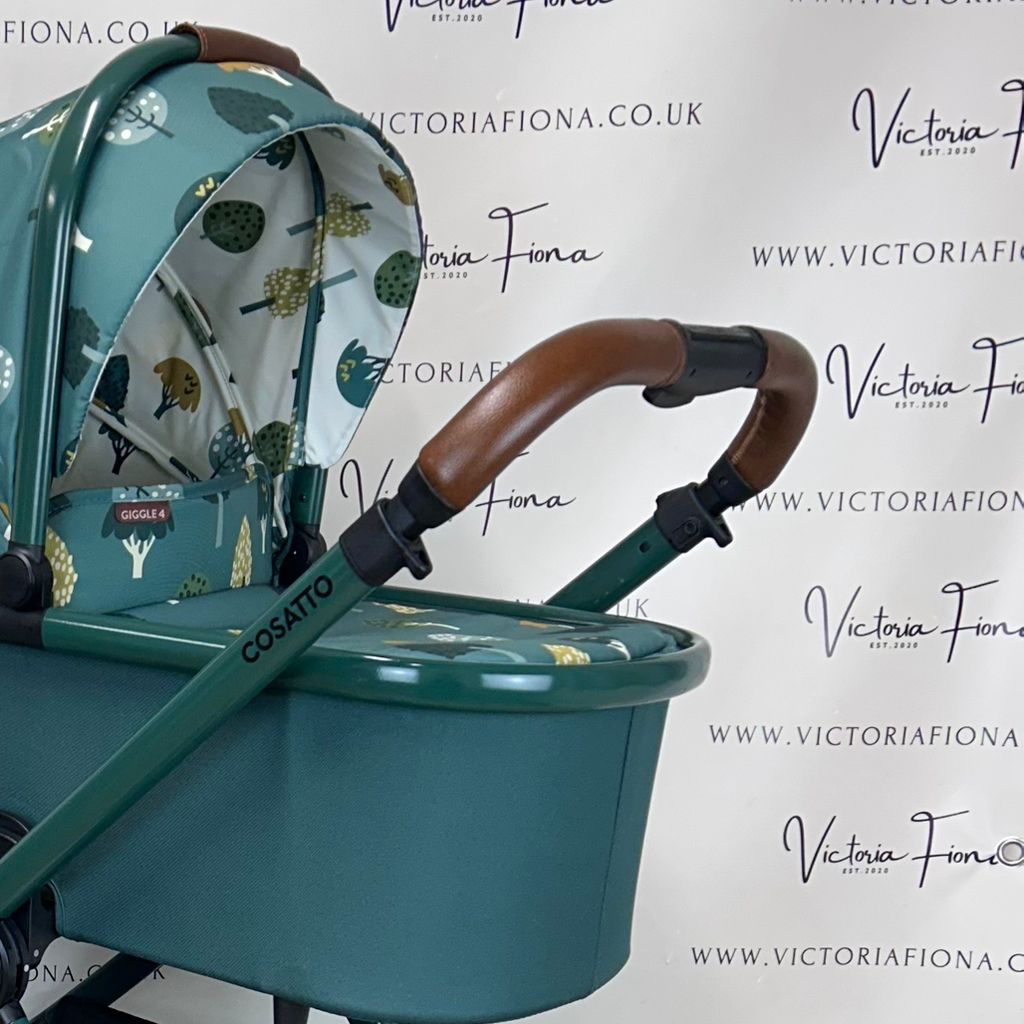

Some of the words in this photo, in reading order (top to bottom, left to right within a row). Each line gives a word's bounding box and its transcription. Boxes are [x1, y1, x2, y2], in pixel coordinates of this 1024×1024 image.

[432, 14, 483, 22] EST.2020
[359, 103, 703, 134] ICTORIAFIONA.CO.UK
[852, 87, 999, 169] Victoria
[920, 147, 976, 156] EST.2020
[488, 202, 604, 294] Fiona
[752, 240, 1024, 267] WWW.VICTORIAFI
[380, 361, 511, 384] CTORIAF
[826, 343, 971, 419] Victoria
[120, 508, 158, 520] GIGGLE
[158, 508, 166, 519] 4
[731, 490, 1024, 513] WW.VICTORIAFION
[241, 575, 333, 664] COSATTO
[804, 585, 939, 658] Victoria
[783, 815, 910, 884] Victoria
